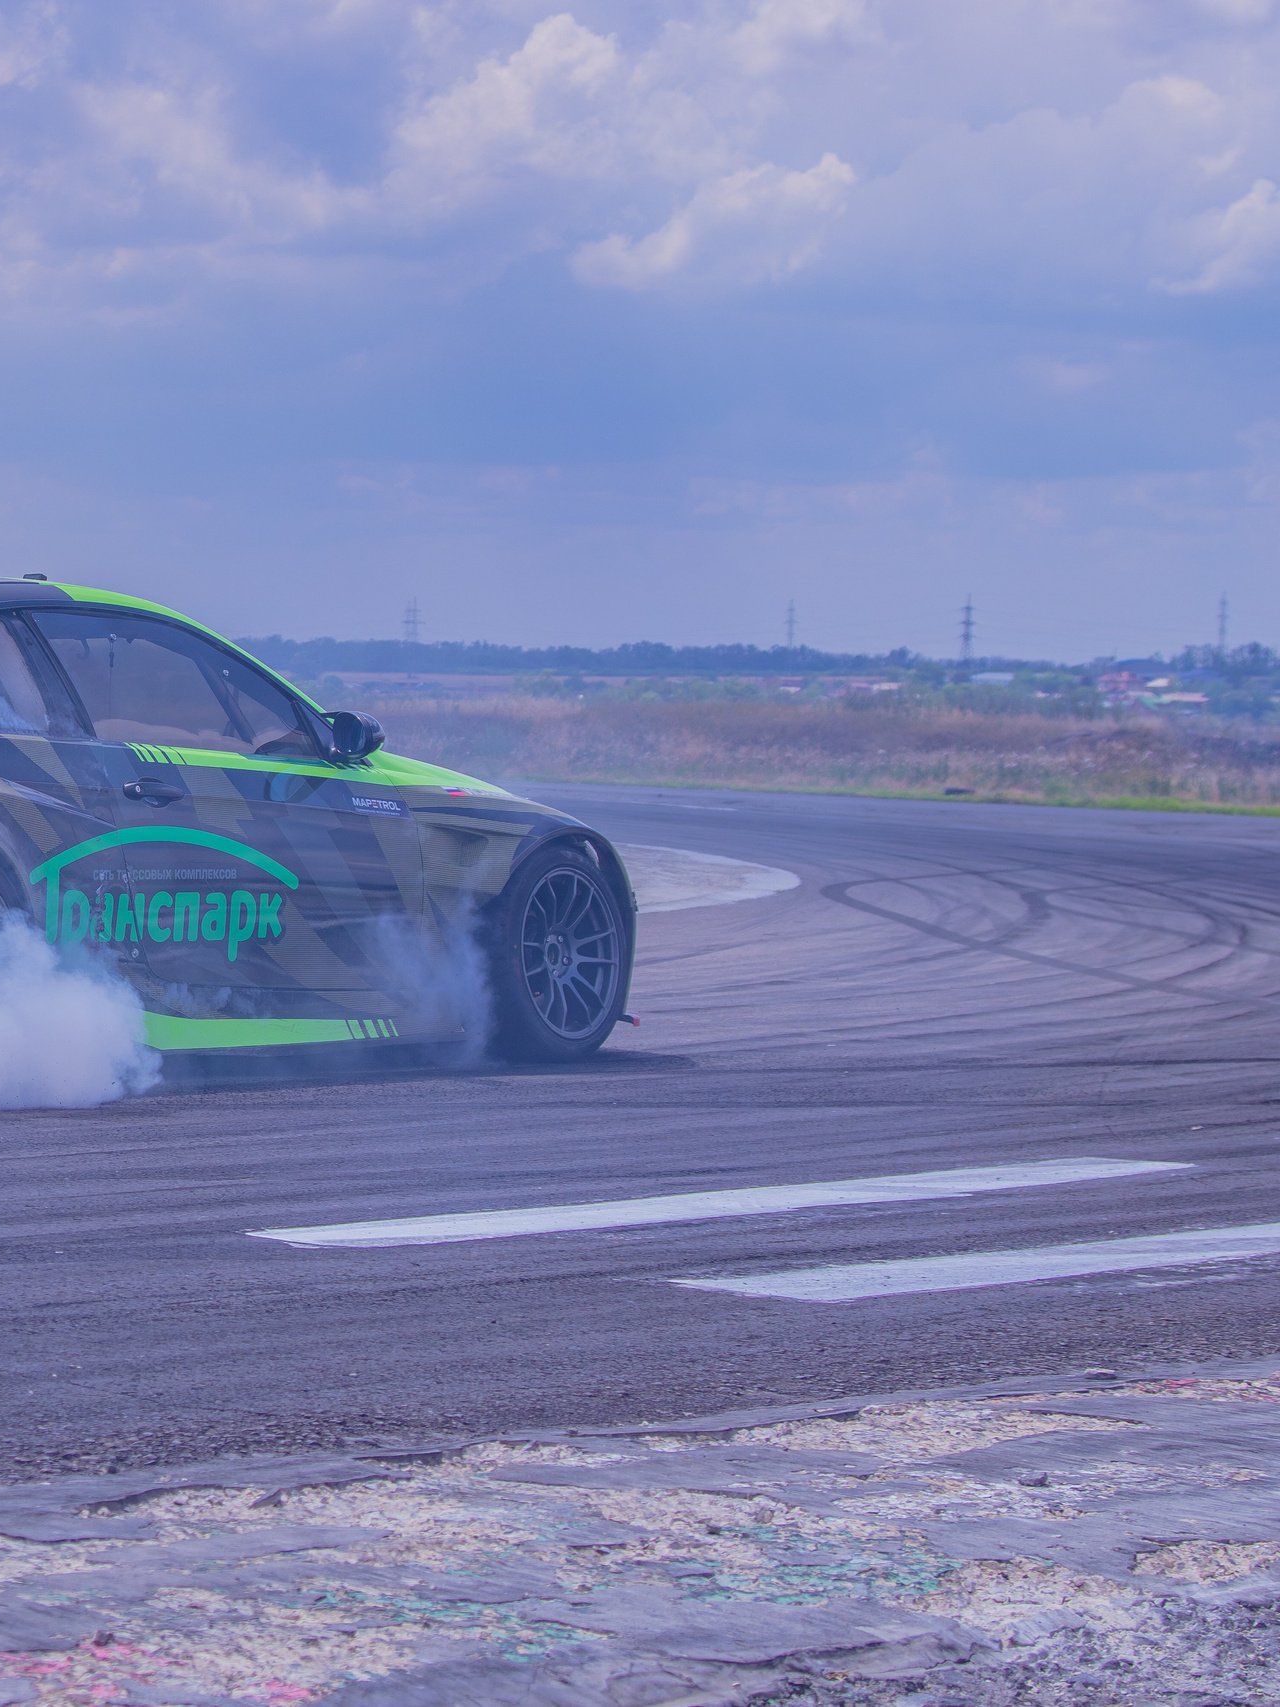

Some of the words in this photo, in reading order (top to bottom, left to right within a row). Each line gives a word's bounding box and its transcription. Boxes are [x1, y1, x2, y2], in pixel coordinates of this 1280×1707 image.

[352, 797, 401, 811] MAPETROL
[117, 869, 172, 880] ТССОВЫХ
[174, 868, 237, 880] КОМПЛЕКСОВ
